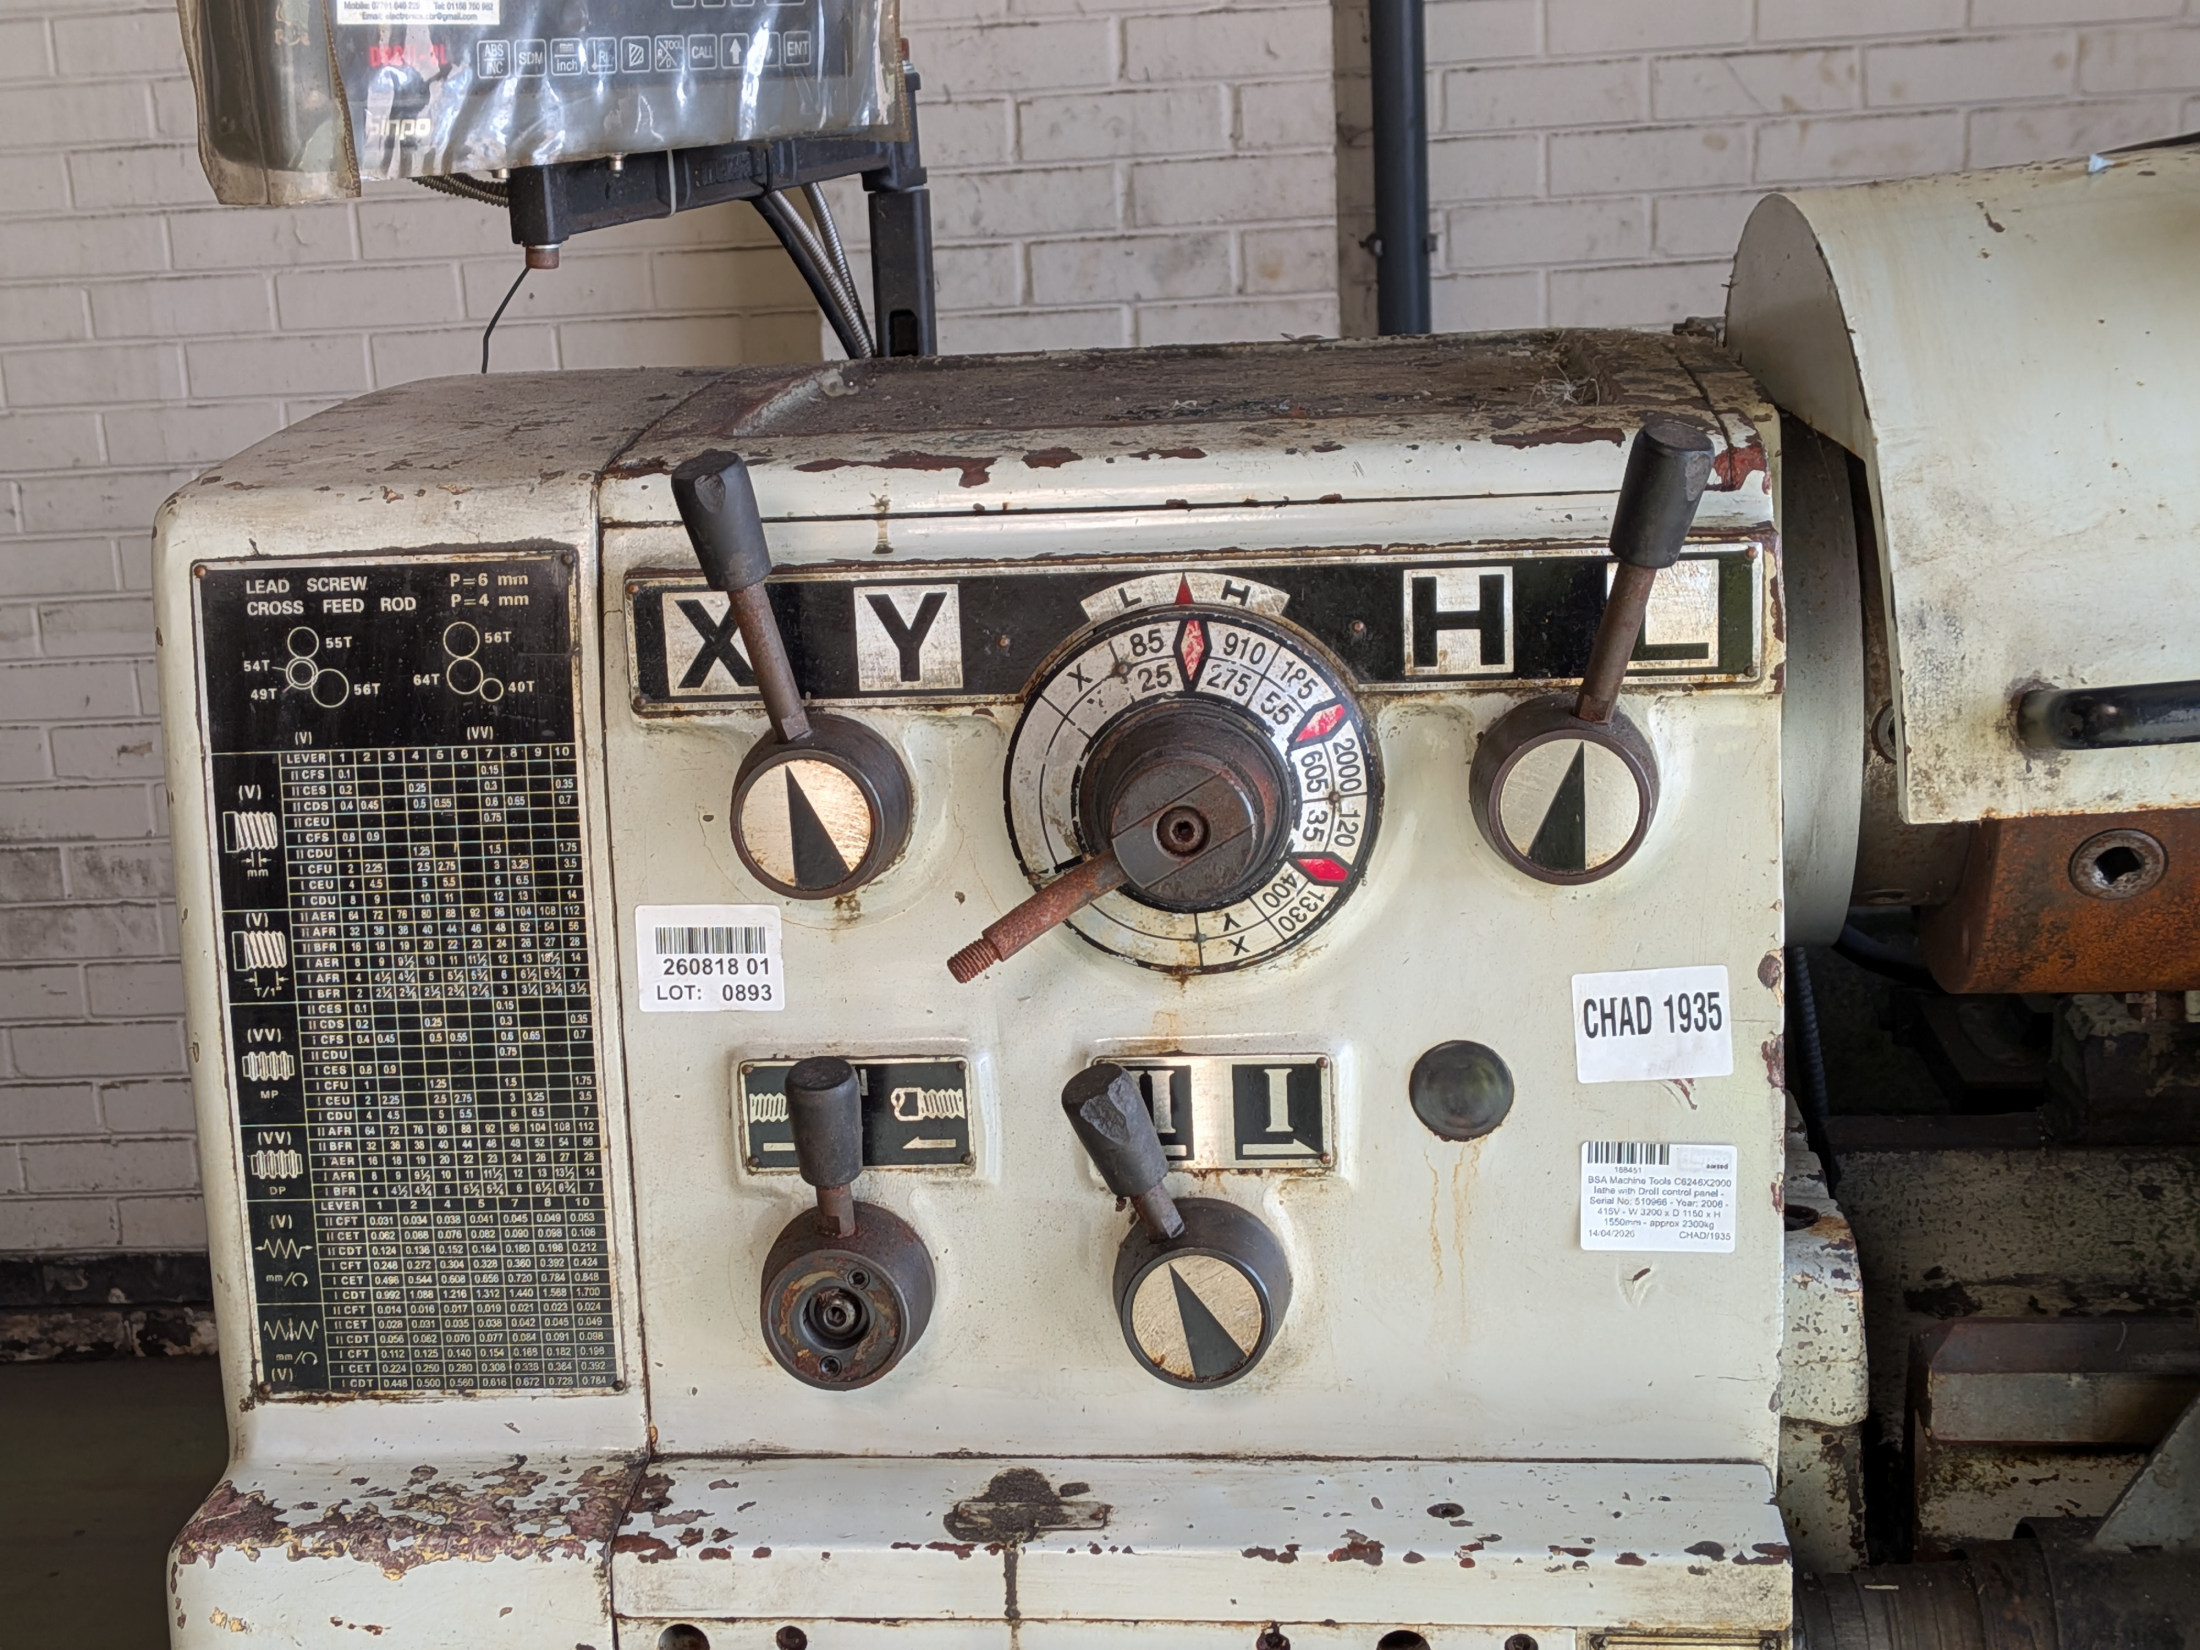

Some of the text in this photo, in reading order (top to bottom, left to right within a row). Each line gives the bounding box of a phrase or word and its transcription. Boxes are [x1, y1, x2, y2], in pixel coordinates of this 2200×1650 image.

[485, 44, 504, 57] ABS
[692, 46, 713, 59] CALL
[787, 41, 809, 57] ENT
[557, 59, 577, 71] inch
[246, 579, 290, 594] LEAD
[307, 576, 368, 592] SCREW
[497, 574, 529, 586] mm
[1118, 587, 1142, 608] L
[1221, 579, 1251, 606] H
[247, 600, 304, 616] CROSS
[323, 598, 365, 613] FEED
[380, 597, 417, 612] ROD
[499, 594, 529, 606] mm
[1412, 574, 1505, 667] H
[325, 636, 352, 648] 55T
[484, 631, 512, 643] 56T
[674, 591, 948, 689] X Y
[1129, 628, 1164, 657] 85
[1223, 632, 1267, 665] 910
[243, 660, 270, 672] 54T
[413, 674, 440, 686] 64T
[1067, 663, 1093, 692] X
[1138, 663, 1173, 693] 25
[1206, 663, 1253, 697] 275
[250, 688, 277, 700] 49T
[354, 683, 380, 695] 56T
[508, 681, 535, 693] 40T
[1260, 691, 1296, 725] 55
[295, 731, 312, 745] (V)
[466, 726, 494, 741] (VV)
[287, 747, 570, 764] LEVER 1 2 3 4 5 6 7 8 9 10
[302, 769, 325, 780] CFS
[338, 769, 351, 779] 0.1
[481, 765, 499, 775] 0.15
[1300, 750, 1329, 793] 605
[1333, 738, 1362, 793] 2000
[238, 785, 262, 800] (V)
[303, 786, 326, 795] CES
[339, 785, 353, 795] 0.2
[484, 781, 497, 791] 0.3
[555, 779, 573, 789] 0.35
[304, 801, 329, 811] CDS
[340, 800, 353, 810] 0.4
[361, 800, 379, 810] 0.45
[434, 798, 452, 808] 0.55
[485, 797, 498, 807] 0.6
[559, 795, 571, 805] 0.7
[1302, 809, 1328, 843] 35
[1333, 809, 1361, 847] 120
[247, 869, 269, 878] mm
[1262, 872, 1298, 909] 400
[1278, 889, 1326, 932] 1330
[246, 912, 269, 927] (V)
[1223, 912, 1242, 932] Y
[1227, 935, 1250, 957] X
[663, 958, 769, 975] 260818 01
[657, 984, 772, 1001] LOT: 0893
[1583, 992, 1722, 1039] CHAD 1935
[247, 1028, 282, 1043] (VV)
[260, 1090, 279, 1099] MP
[258, 1131, 291, 1145] (VV)
[1588, 1176, 1607, 1184] BSA
[1610, 1176, 1646, 1185] Machine
[1649, 1177, 1671, 1185] Tools
[269, 1187, 286, 1196] DP
[1594, 1186, 1615, 1194] lathe
[1662, 1188, 1691, 1196] control
[1694, 1189, 1718, 1198] panel
[321, 1201, 360, 1211] LEVER
[1676, 1199, 1698, 1208] Year:
[1641, 1208, 1662, 1216] 3200
[1673, 1209, 1679, 1217] D
[1683, 1210, 1703, 1218] 1150
[270, 1215, 292, 1230] (V)
[1605, 1218, 1641, 1226] 1550mm
[1650, 1220, 1680, 1228] approx
[1682, 1220, 1714, 1230] 2300kg
[1679, 1231, 1731, 1241] CHAD/1935
[339, 1246, 362, 1255] CDT
[372, 1246, 396, 1255] 0.124
[572, 1243, 597, 1252] 0.212
[271, 1368, 294, 1382] (V)
